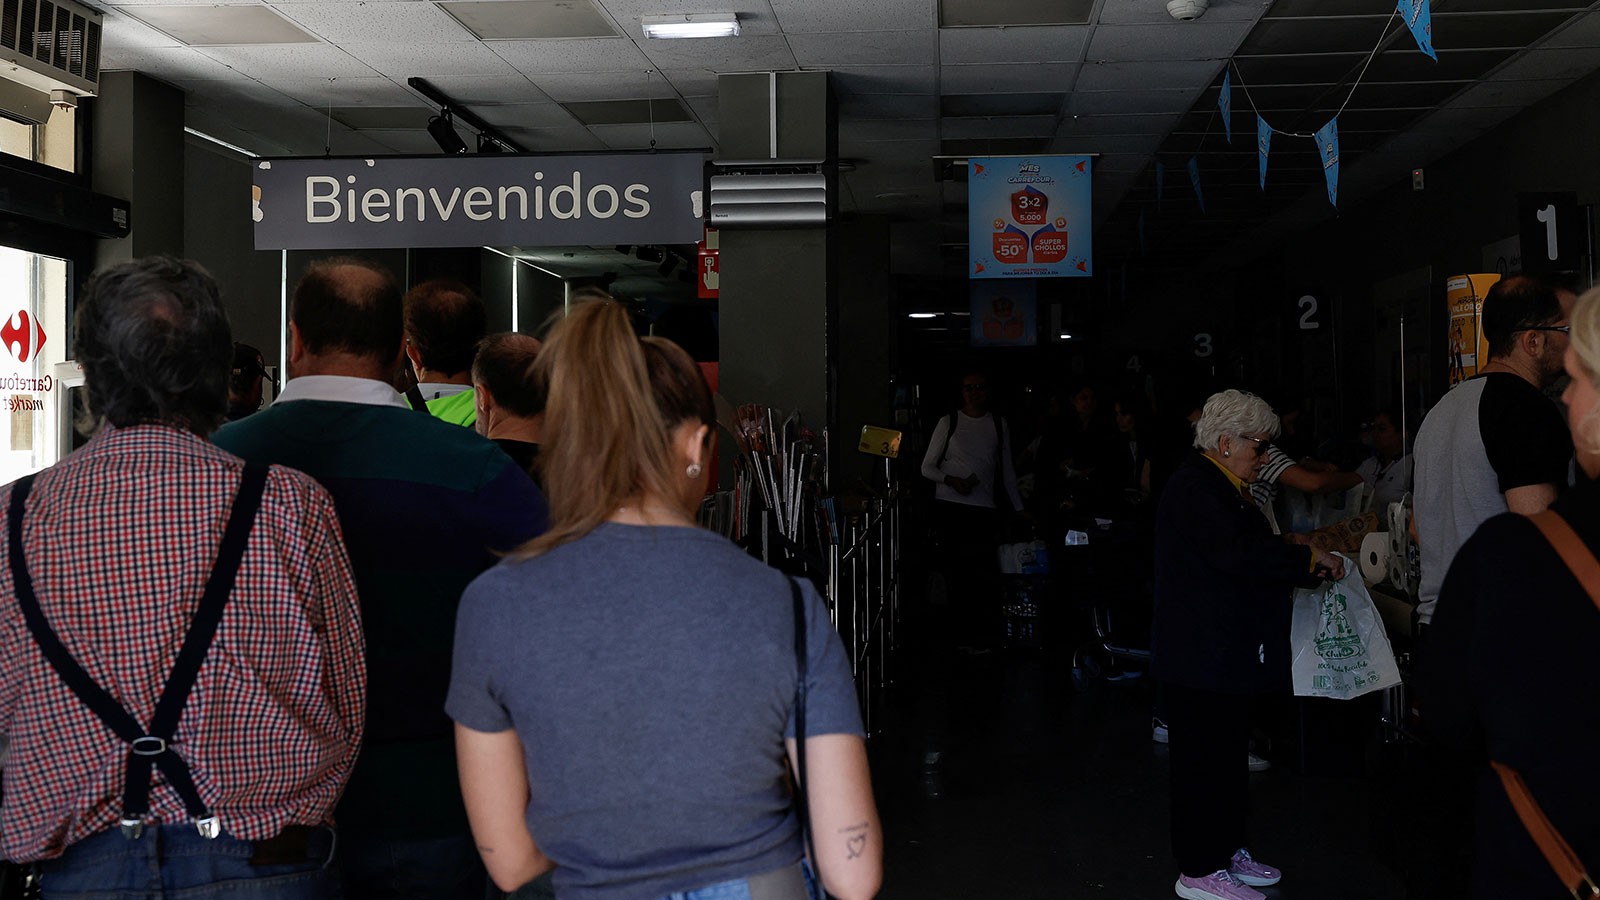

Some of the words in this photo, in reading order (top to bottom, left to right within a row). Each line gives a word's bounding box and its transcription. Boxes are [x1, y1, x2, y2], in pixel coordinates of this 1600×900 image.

[1007, 176, 1051, 184] CARREFOUR
[306, 171, 651, 223] Bienvenidos
[1536, 204, 1558, 260] 1
[1298, 294, 1320, 330] 2
[1193, 333, 1214, 358] 3
[1125, 354, 1143, 373] 4
